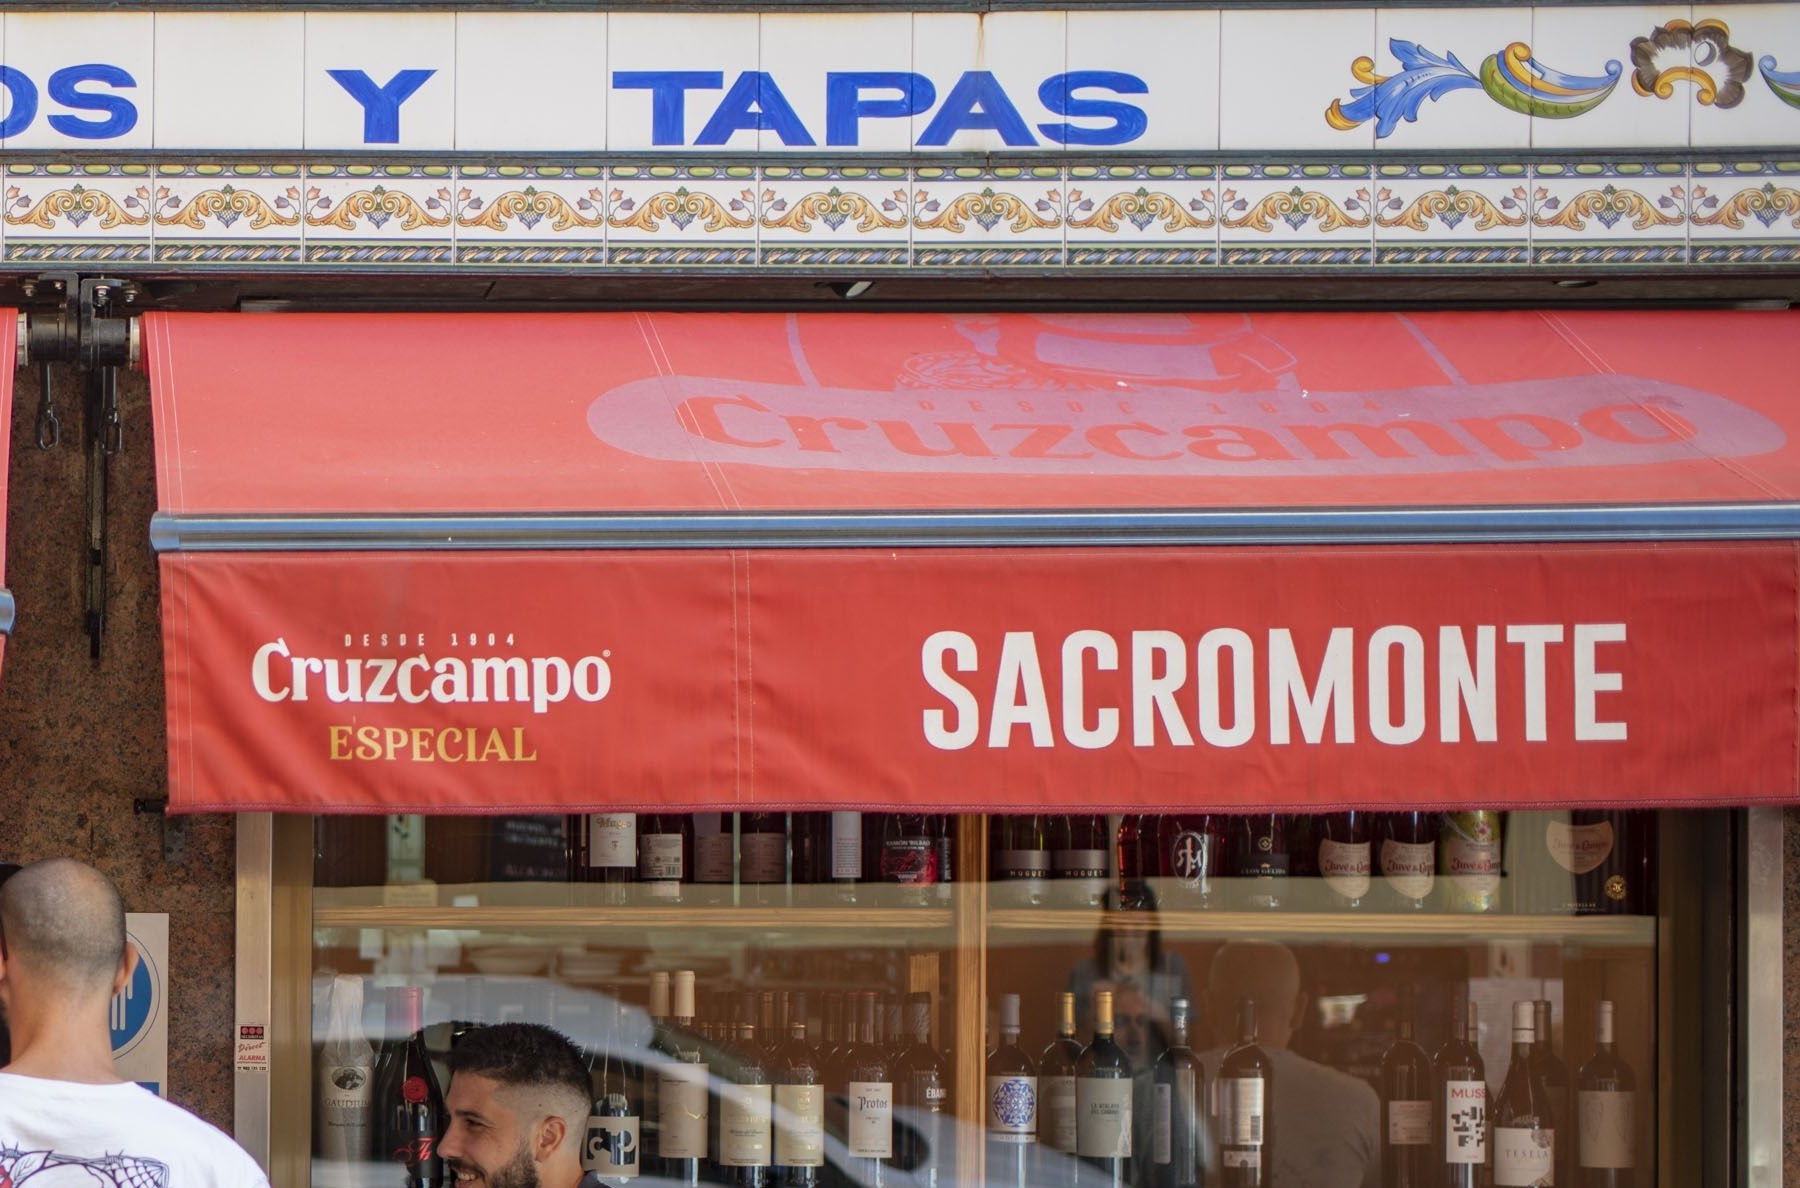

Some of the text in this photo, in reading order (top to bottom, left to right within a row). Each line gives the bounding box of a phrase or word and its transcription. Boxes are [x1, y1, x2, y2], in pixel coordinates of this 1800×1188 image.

[325, 68, 440, 146] Y
[612, 69, 1150, 148] TAPAS
[670, 394, 1699, 463] Cruzcampo
[344, 633, 515, 647] DESDE 1904
[251, 637, 611, 714] Cruzcampo
[921, 623, 1629, 751] SACROMONTE
[328, 725, 537, 762] ESPECIAL
[858, 1096, 888, 1112] Protos
